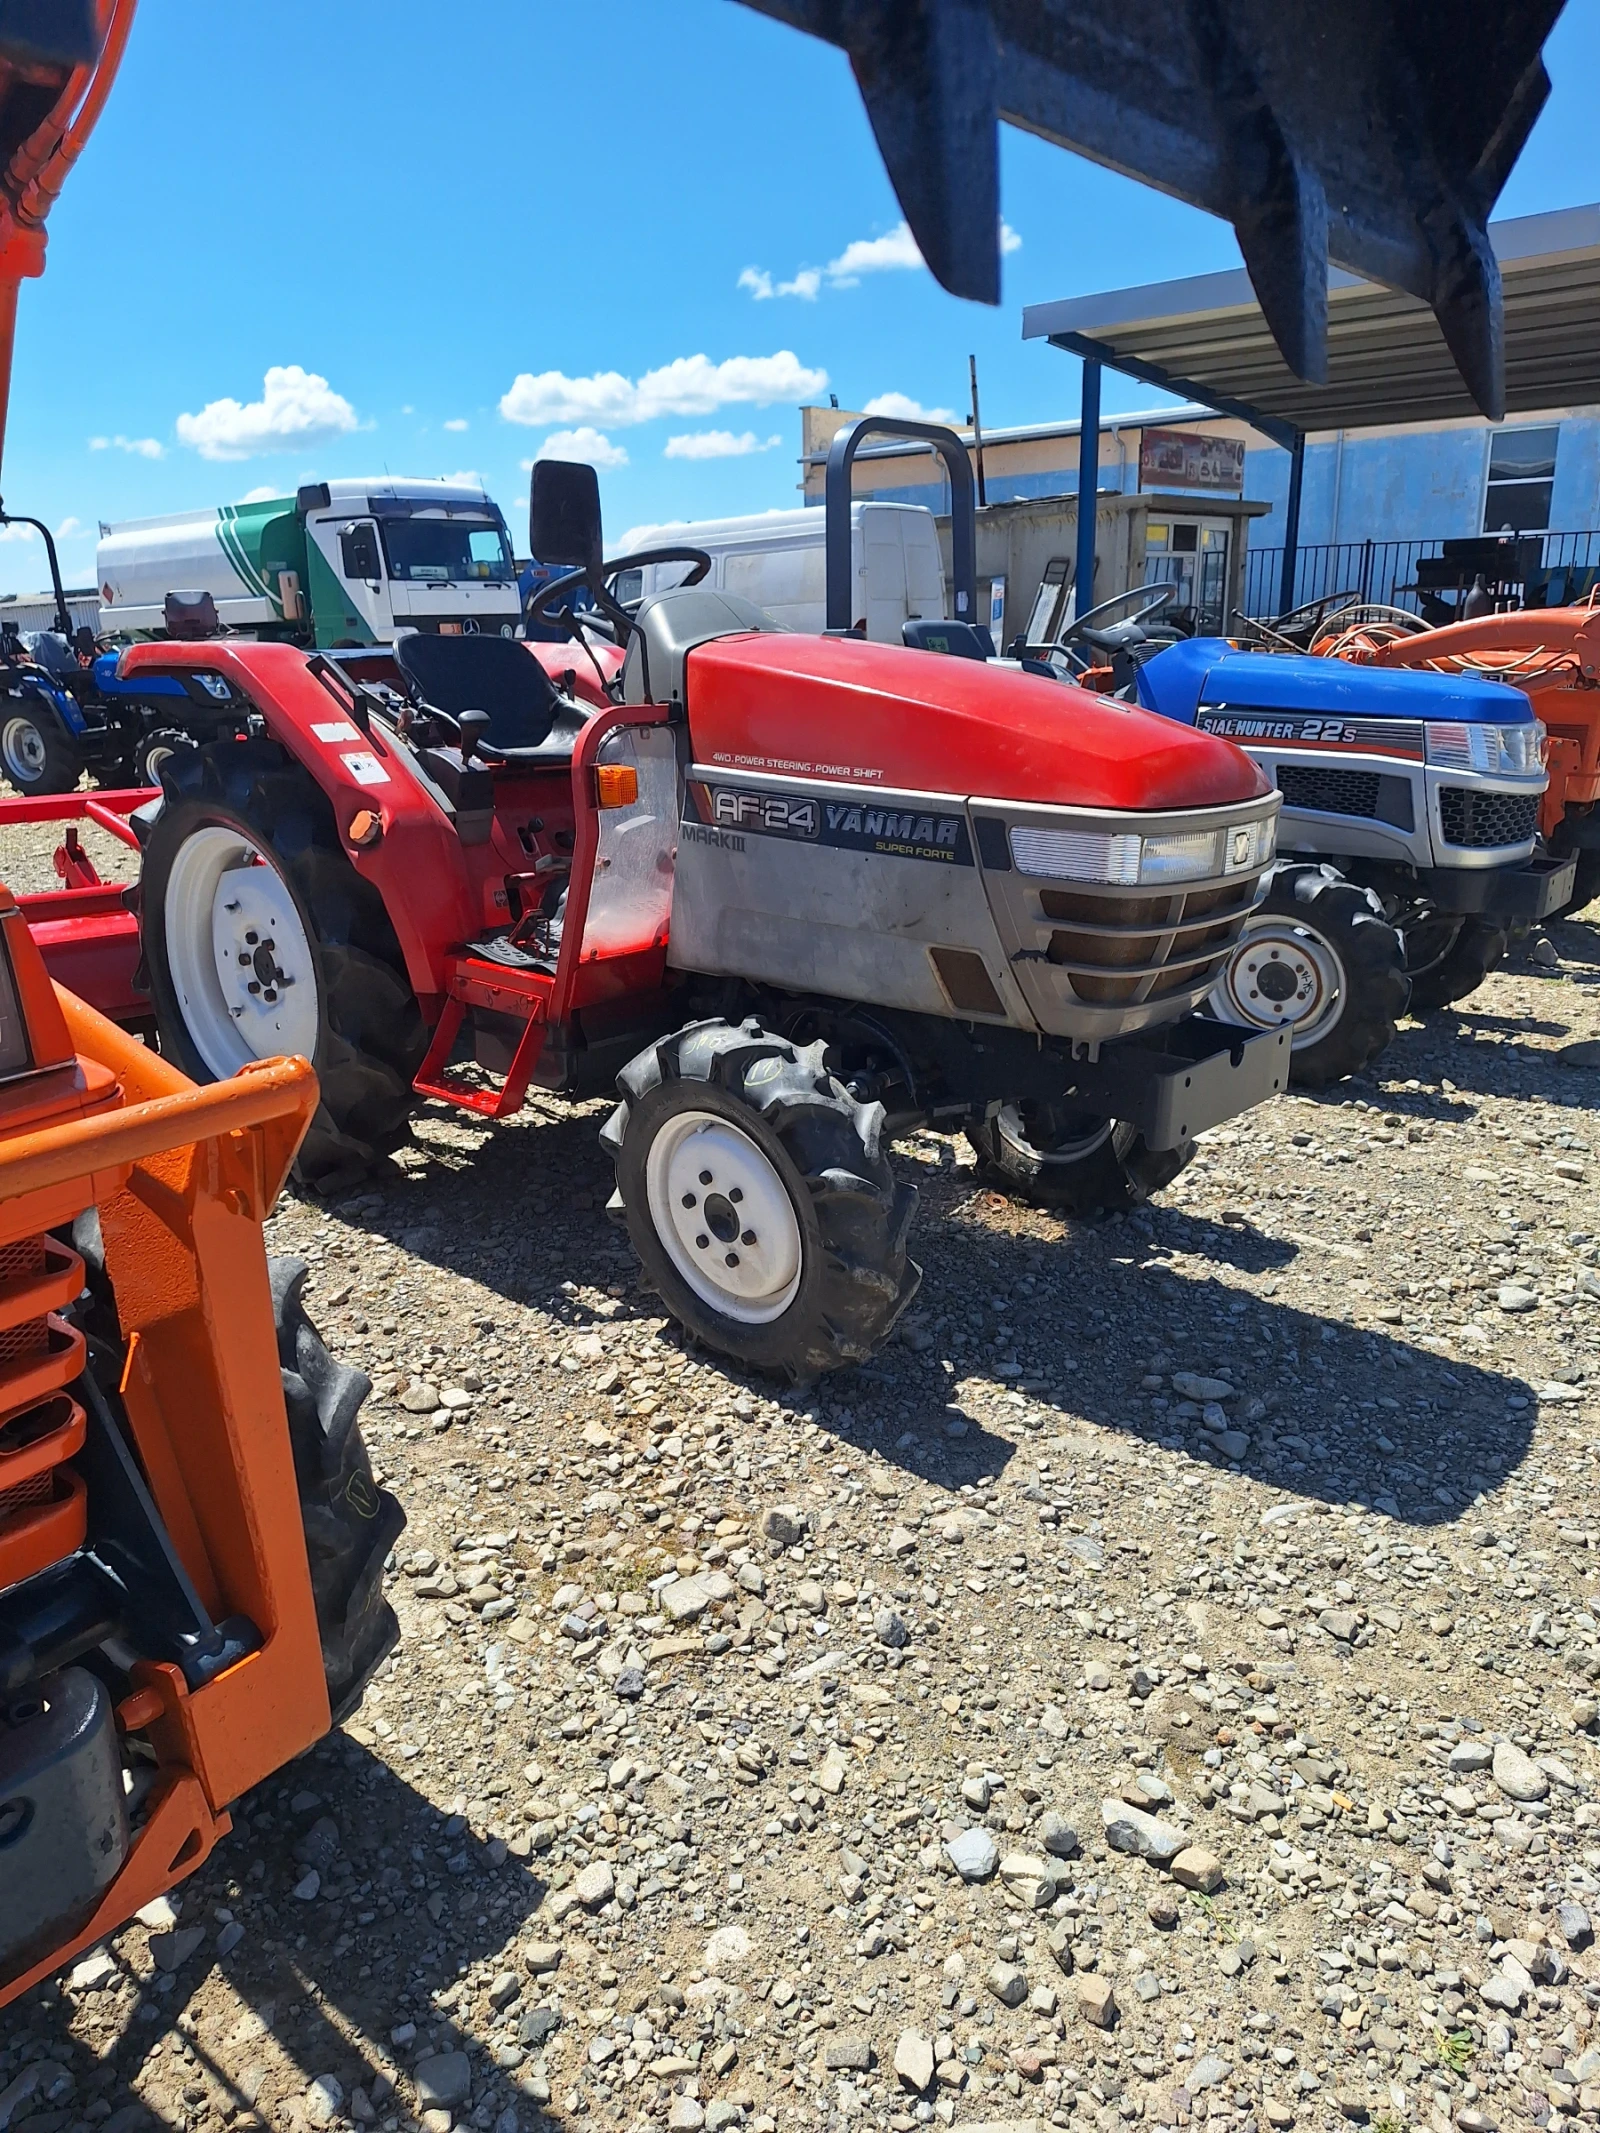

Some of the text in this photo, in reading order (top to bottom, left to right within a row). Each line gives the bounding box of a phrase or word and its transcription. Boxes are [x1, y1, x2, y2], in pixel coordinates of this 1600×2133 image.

[1235, 720, 1294, 739] HUNTER
[852, 768, 884, 780] SHIFT
[825, 805, 961, 845] YANMAR
[682, 825, 732, 849] MARK
[875, 841, 955, 861] SUPER FORTE
